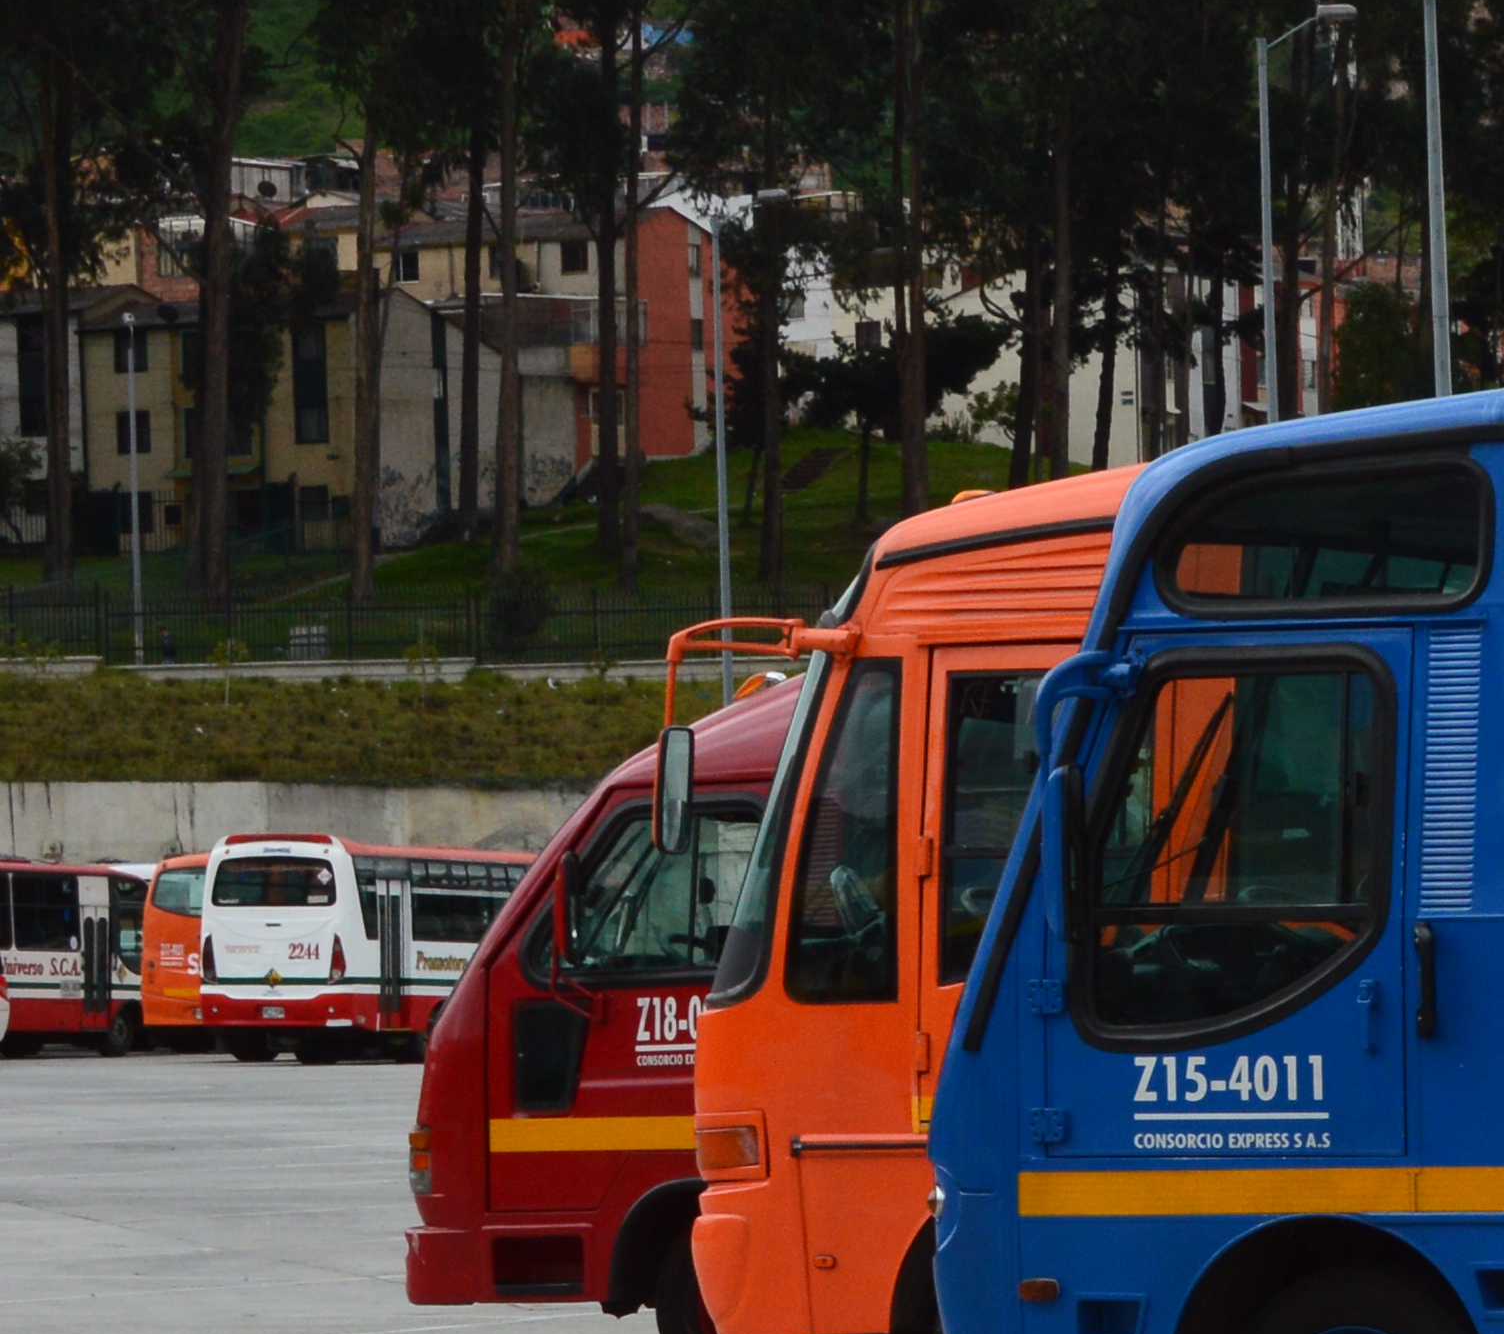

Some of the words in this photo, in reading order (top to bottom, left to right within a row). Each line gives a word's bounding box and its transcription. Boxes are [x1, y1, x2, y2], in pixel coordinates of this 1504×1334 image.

[288, 942, 320, 960] 2244
[636, 996, 708, 1042] Z18-0
[636, 1054, 683, 1067] CONSORCIO
[1133, 1055, 1323, 1102] Z15-4011
[1134, 1133, 1224, 1149] CONSORCIO
[1229, 1132, 1290, 1149] EXPRESS
